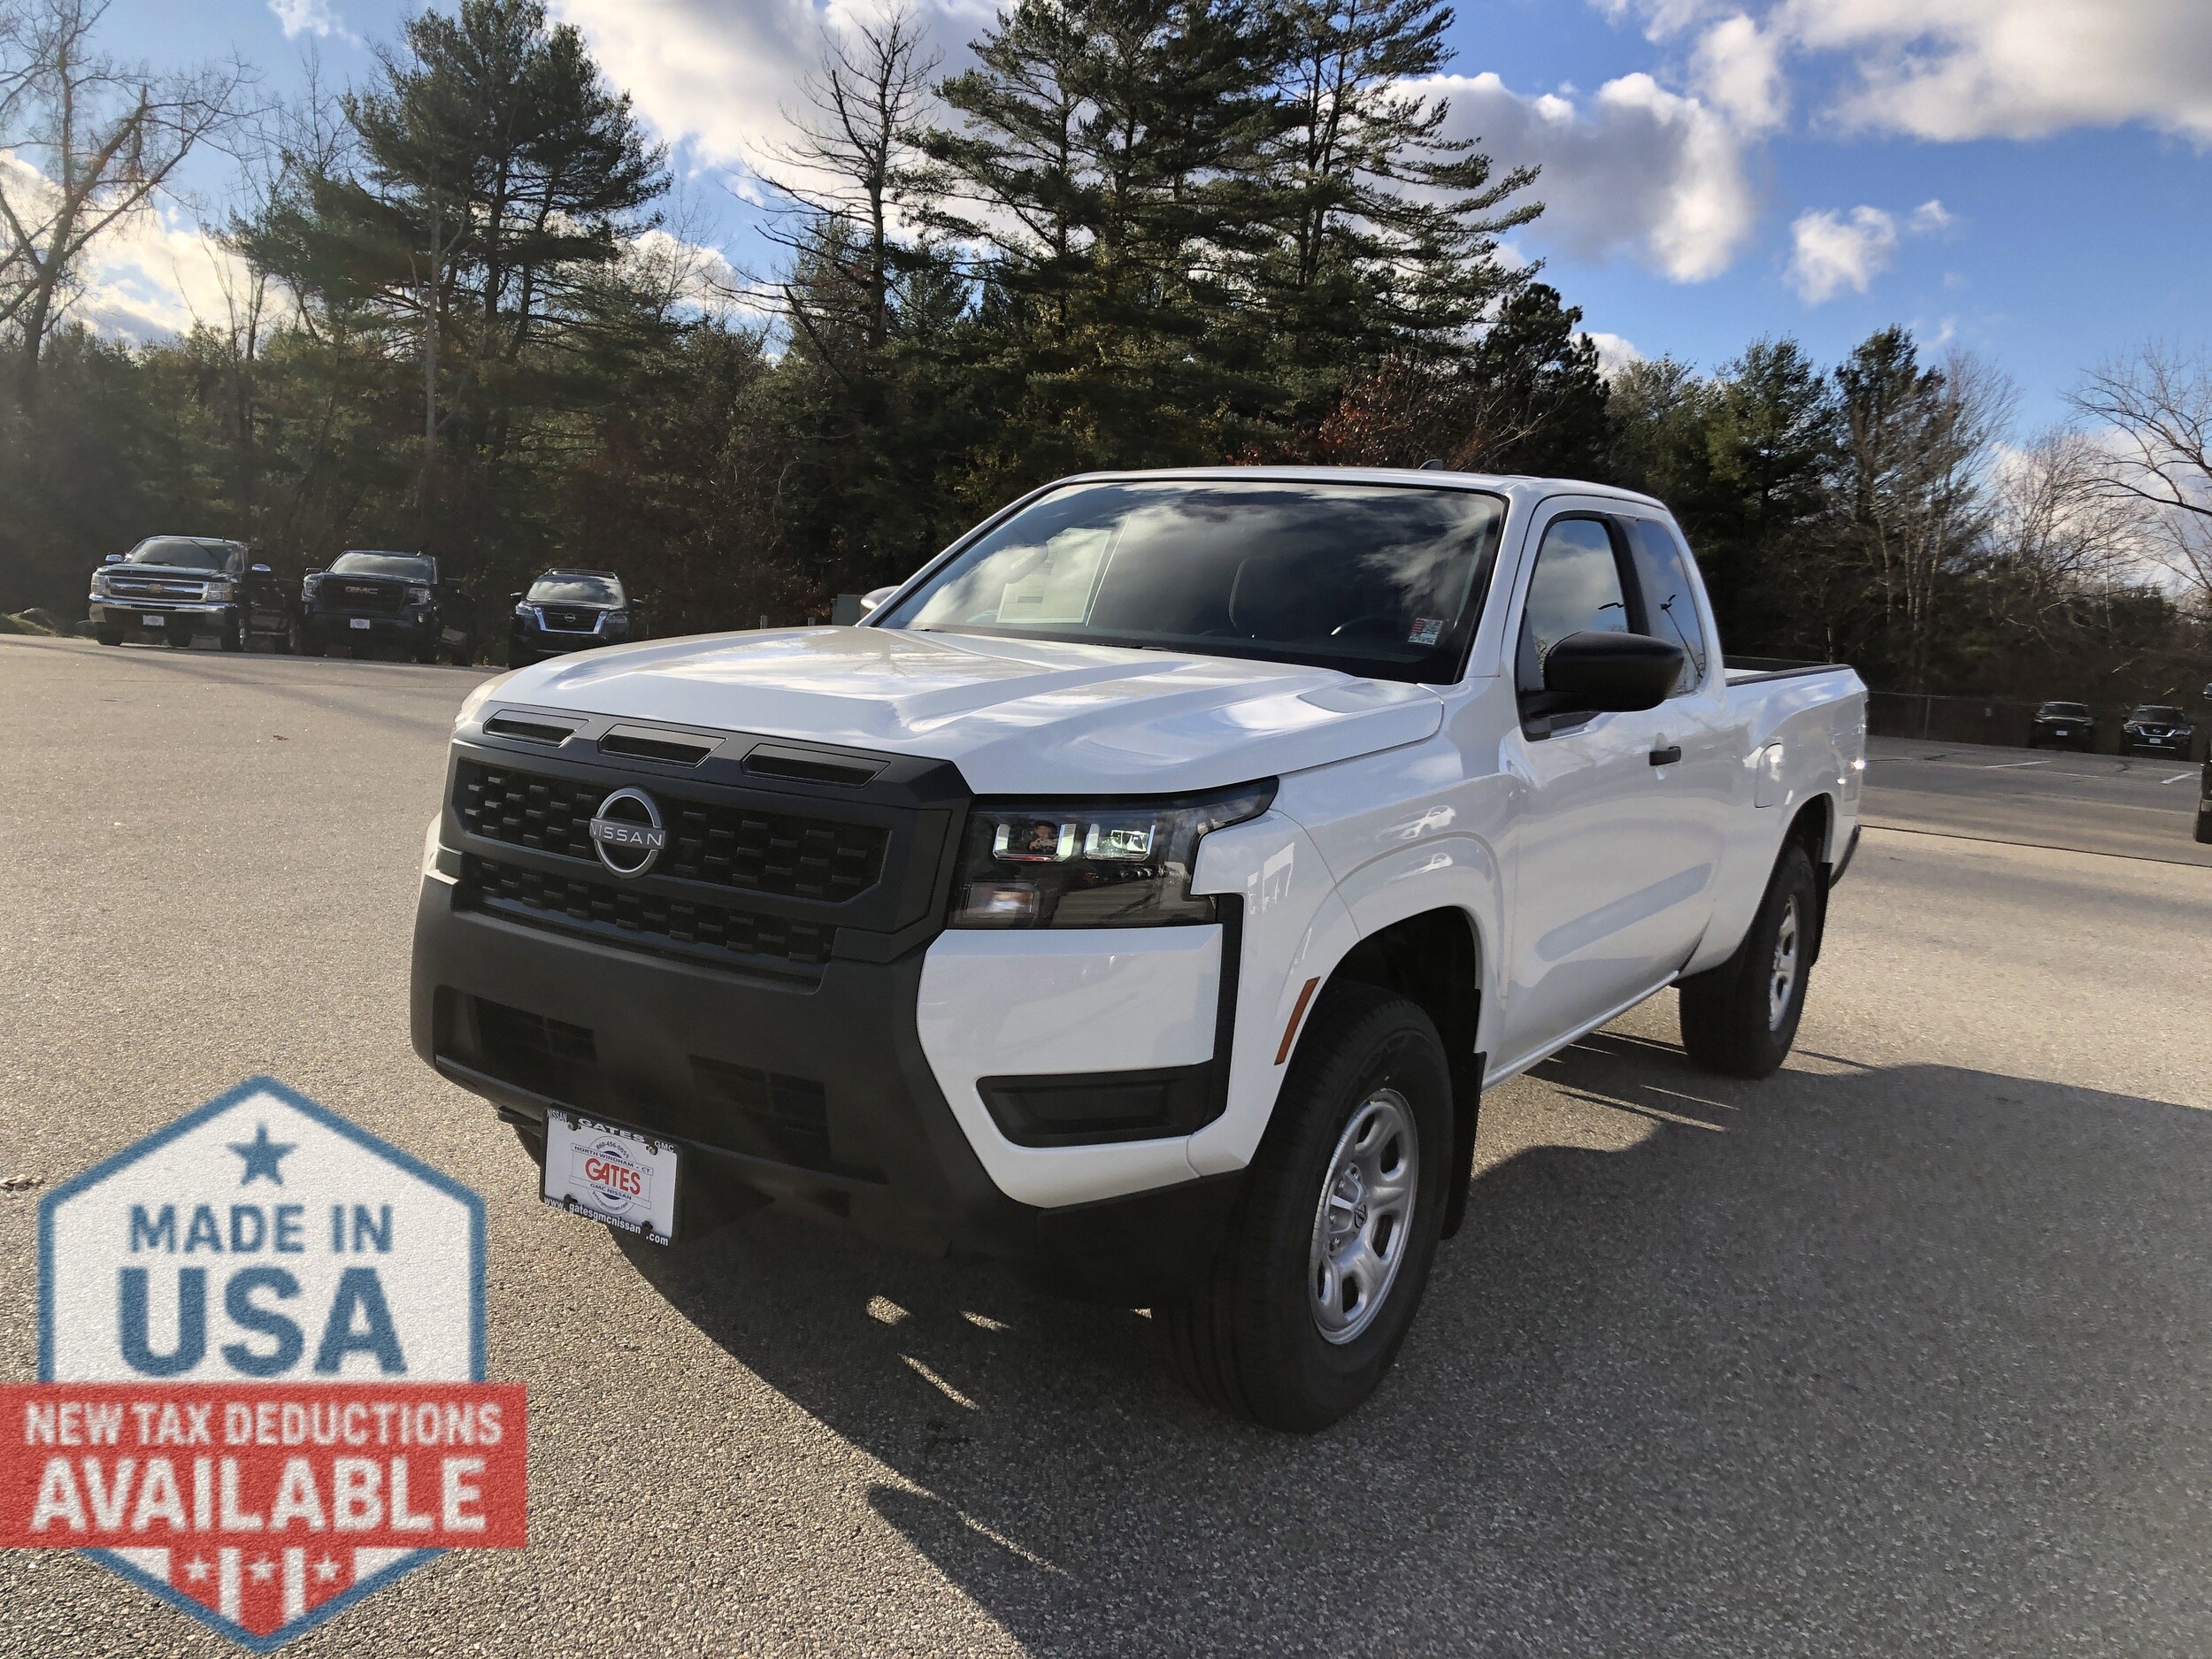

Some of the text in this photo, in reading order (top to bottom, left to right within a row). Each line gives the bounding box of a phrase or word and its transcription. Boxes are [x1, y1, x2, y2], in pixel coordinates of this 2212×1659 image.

[589, 822, 663, 846] NISSAN
[546, 1108, 674, 1152] NISSAN GATES GMC
[574, 1146, 598, 1156] NORTH
[599, 1153, 634, 1168] WINDHAM
[585, 1157, 641, 1195] GATES
[589, 1183, 632, 1201] GMC NISSAN
[569, 1202, 641, 1234] gatesgmcnissan
